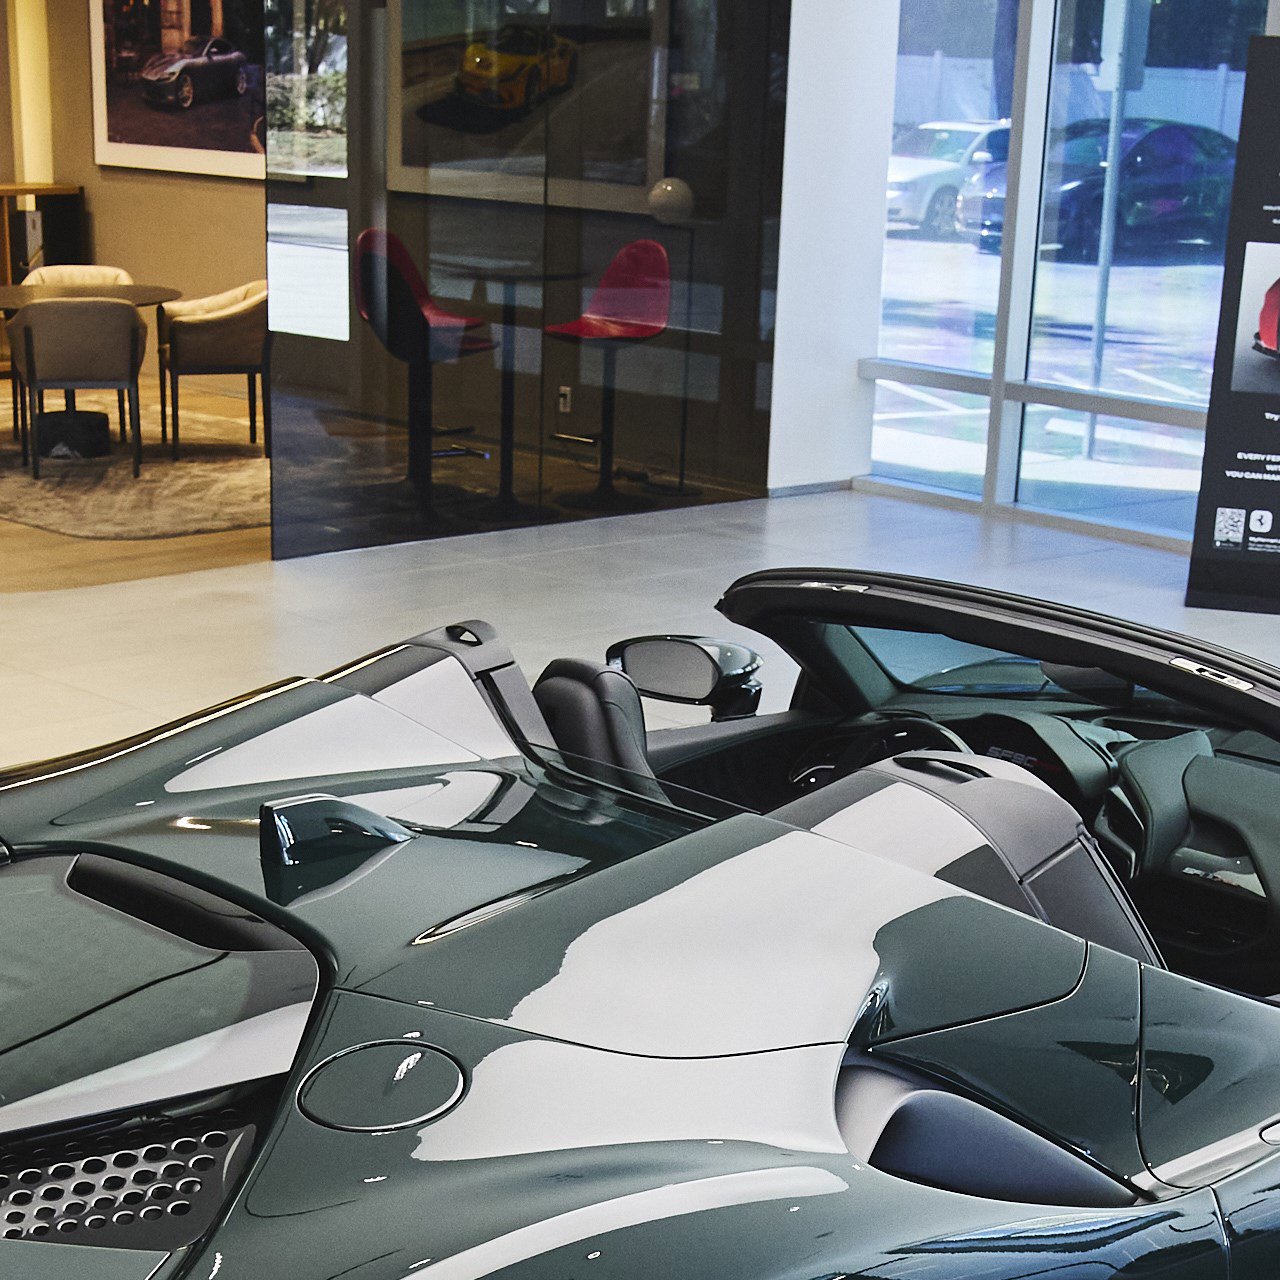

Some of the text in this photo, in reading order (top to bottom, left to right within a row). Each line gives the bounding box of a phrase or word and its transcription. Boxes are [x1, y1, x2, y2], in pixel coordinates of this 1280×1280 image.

[1264, 412, 1279, 422] Try
[1236, 451, 1266, 460] EVERY
[1225, 470, 1244, 478] YOU
[1244, 471, 1263, 479] CAN
